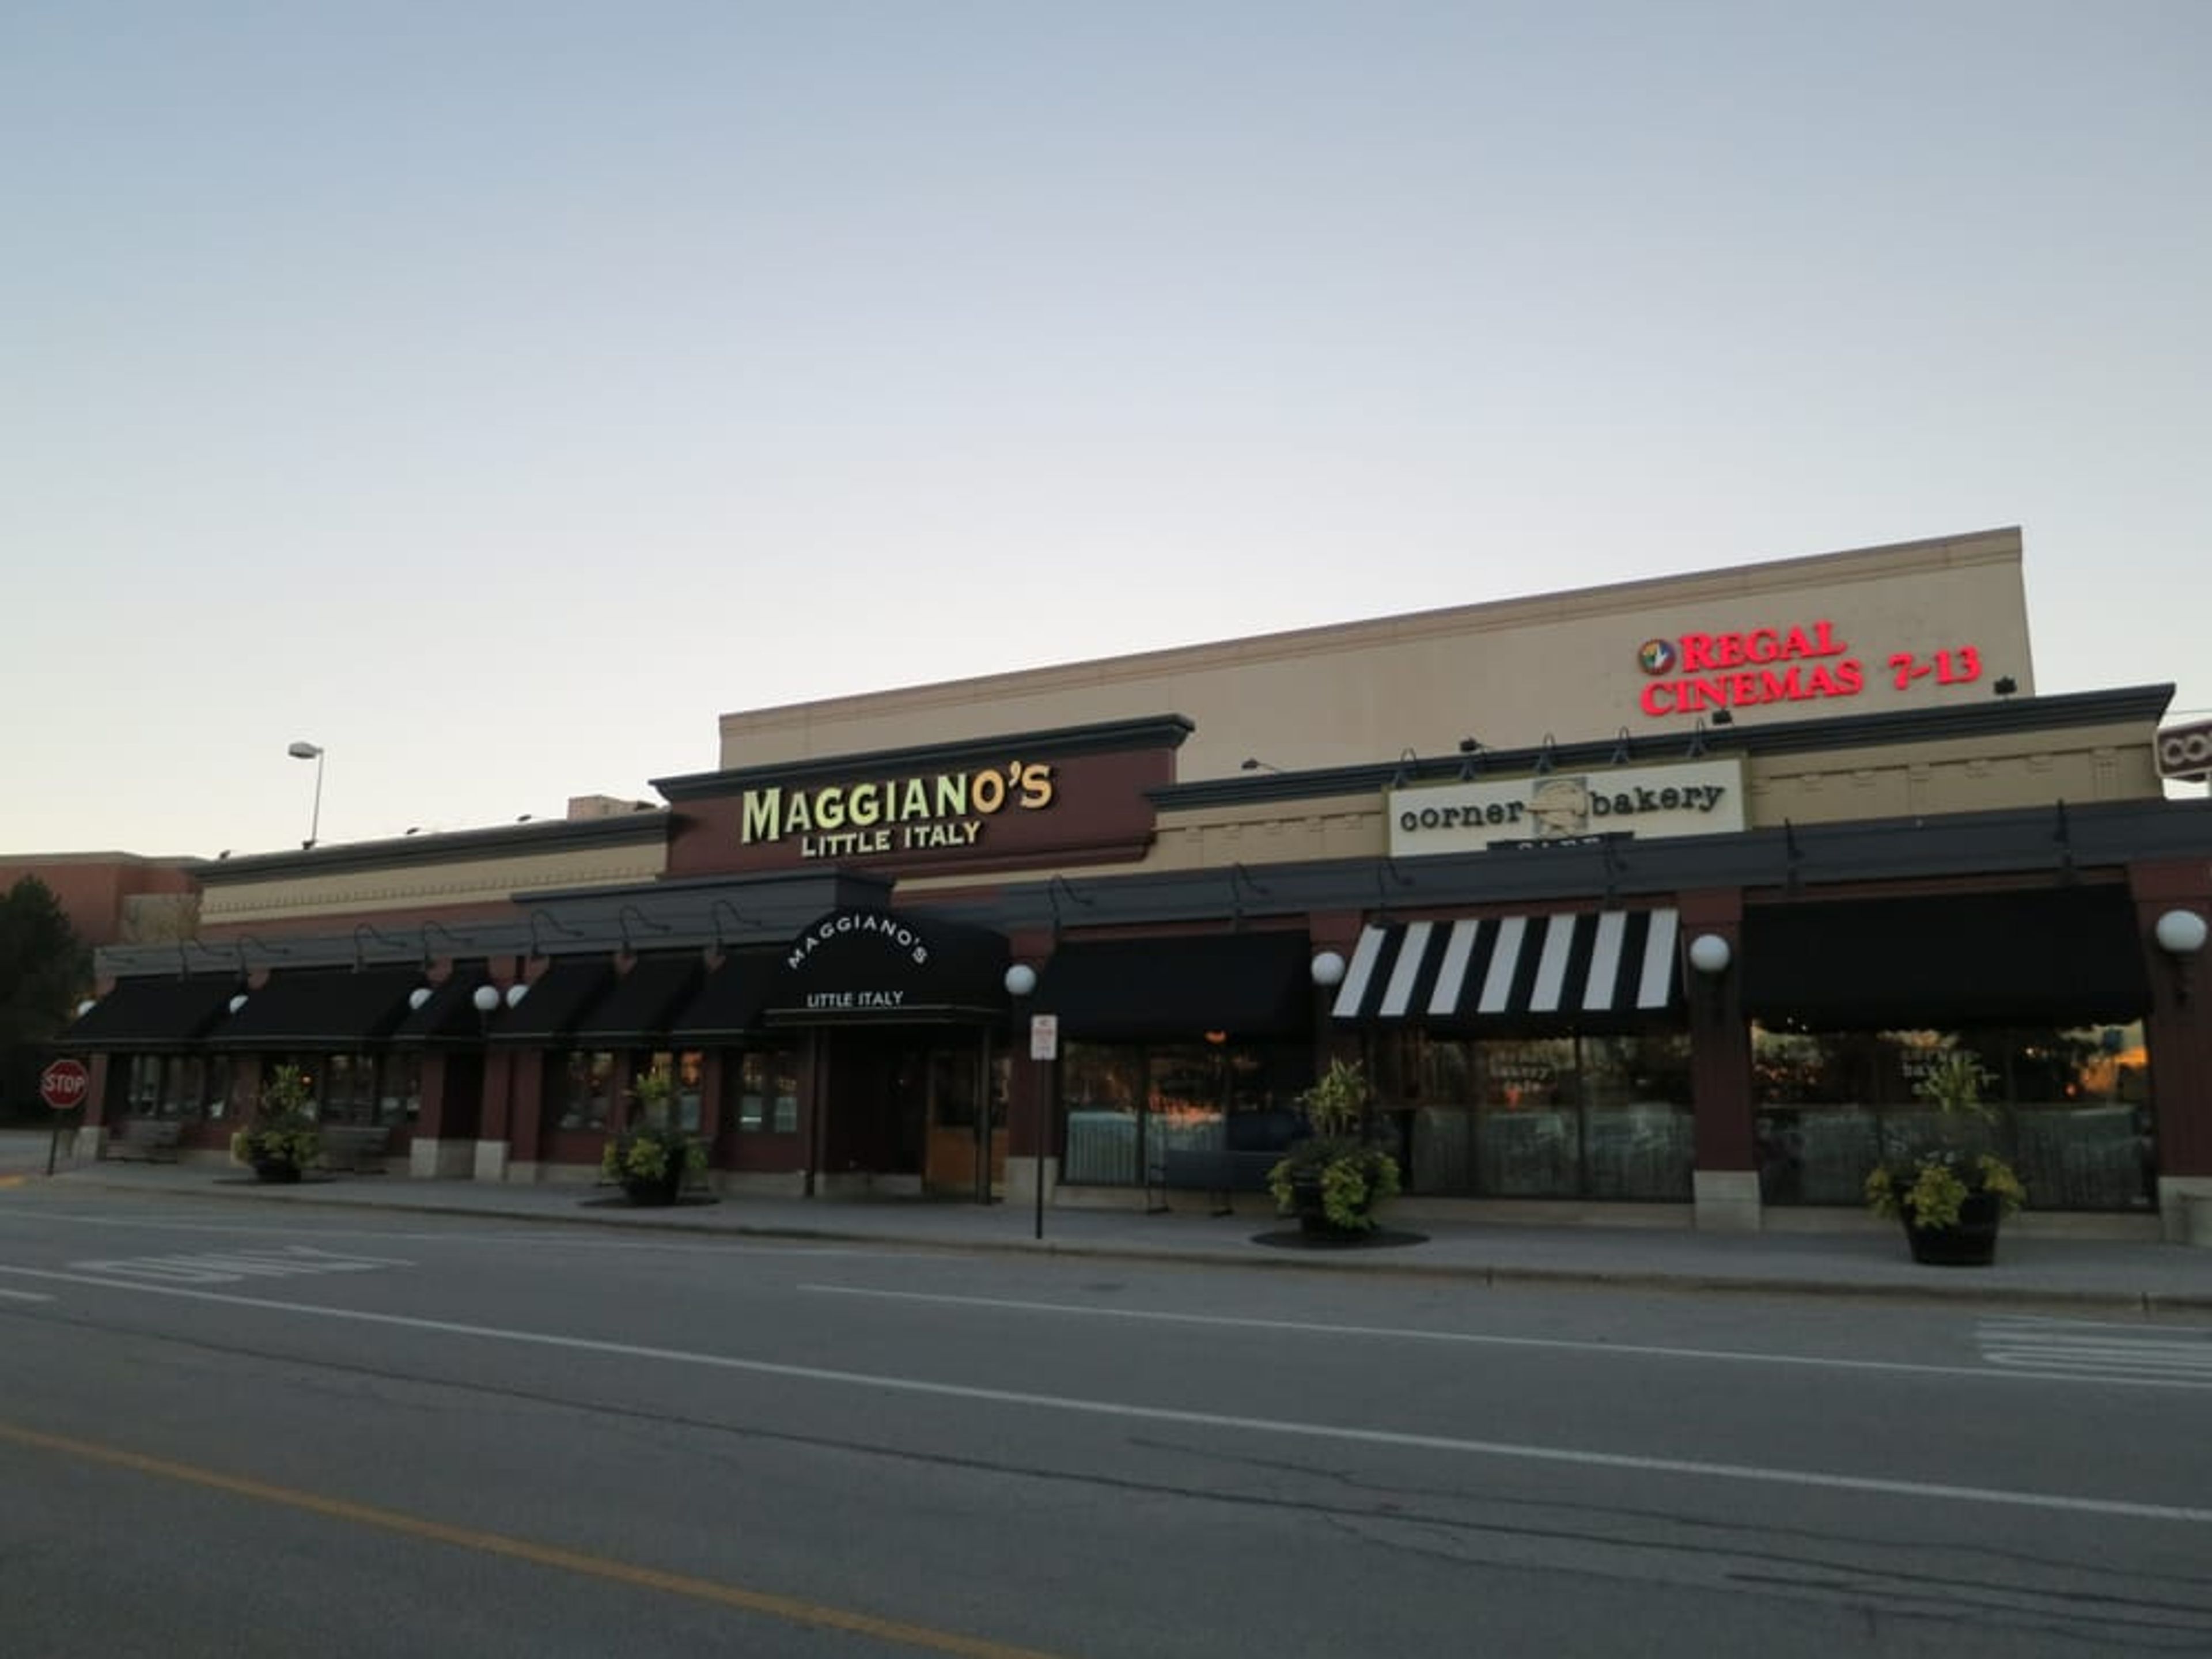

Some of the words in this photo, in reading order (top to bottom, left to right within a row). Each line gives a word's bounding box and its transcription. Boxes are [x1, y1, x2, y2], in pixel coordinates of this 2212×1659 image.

[1679, 620, 1847, 673] REGAL
[1639, 658, 1863, 715] CINEMAS
[1888, 646, 1982, 690] 7-13
[742, 761, 1053, 843] MAGGIANO'S
[1400, 800, 1525, 832] corner
[1589, 785, 1726, 817] bakery
[801, 830, 891, 857] LITTLE
[904, 821, 981, 849] ITALY
[787, 914, 928, 969] MAGGIANO'S
[807, 993, 853, 1008] LITTLE
[858, 991, 904, 1006] ITALY
[45, 1074, 85, 1093] STOP
